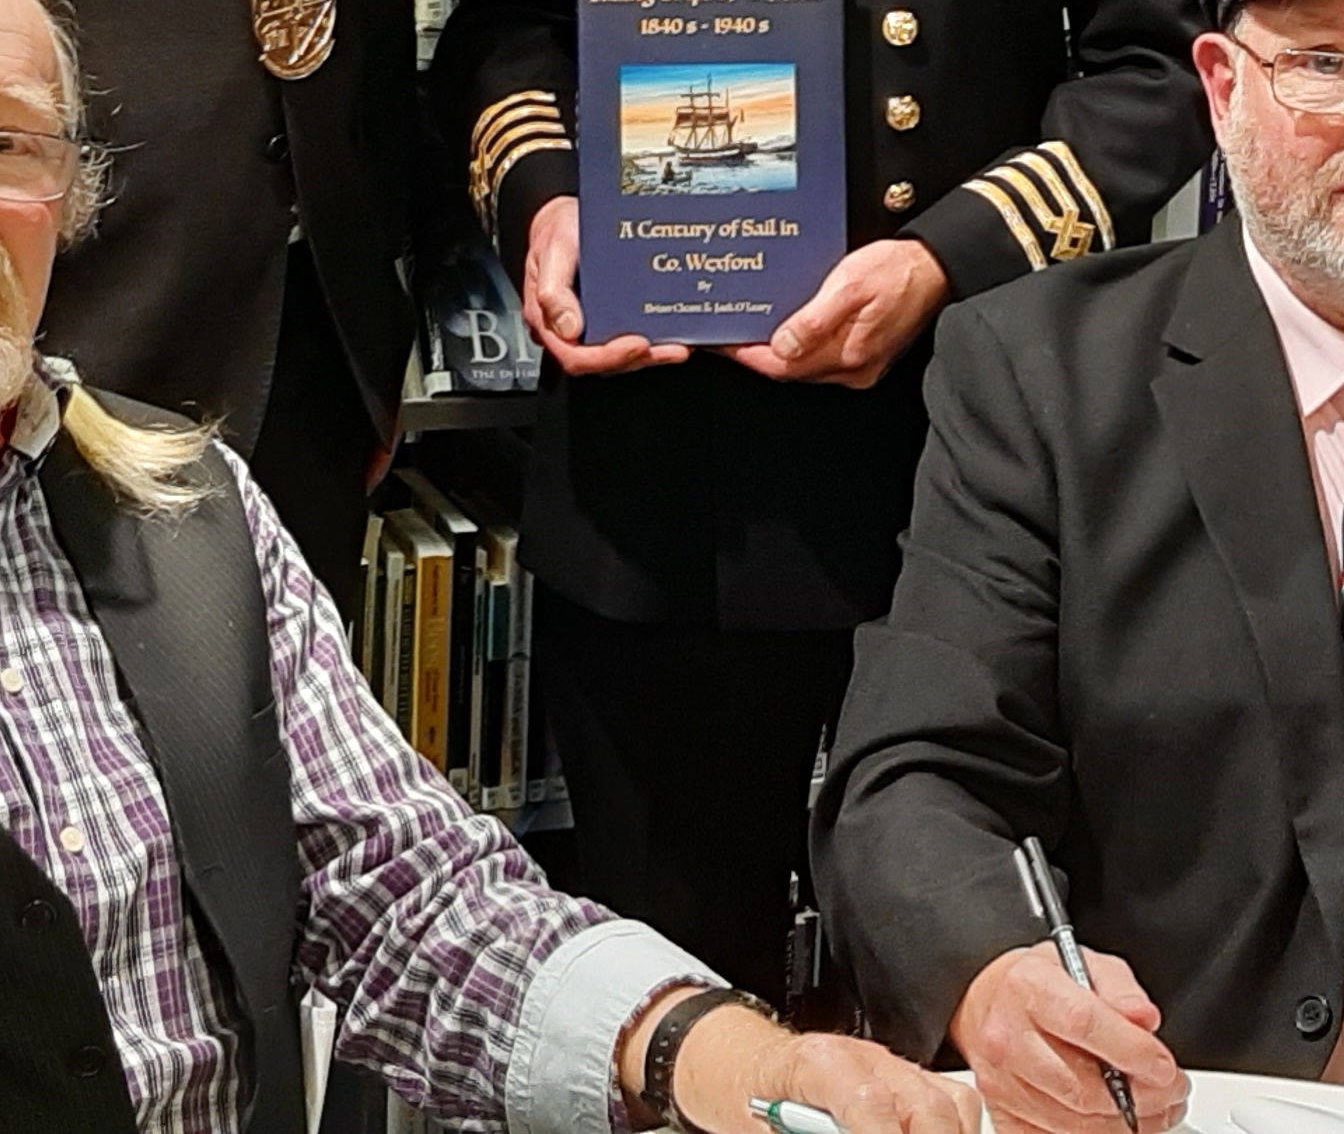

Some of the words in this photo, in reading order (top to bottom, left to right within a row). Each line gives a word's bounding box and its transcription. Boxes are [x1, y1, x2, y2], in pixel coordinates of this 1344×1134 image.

[619, 221, 633, 238] A
[637, 220, 716, 243] Century
[718, 219, 741, 238] of
[741, 219, 777, 237] Sail
[780, 219, 799, 237] in
[652, 253, 682, 272] Co.
[686, 252, 764, 272] Wexford
